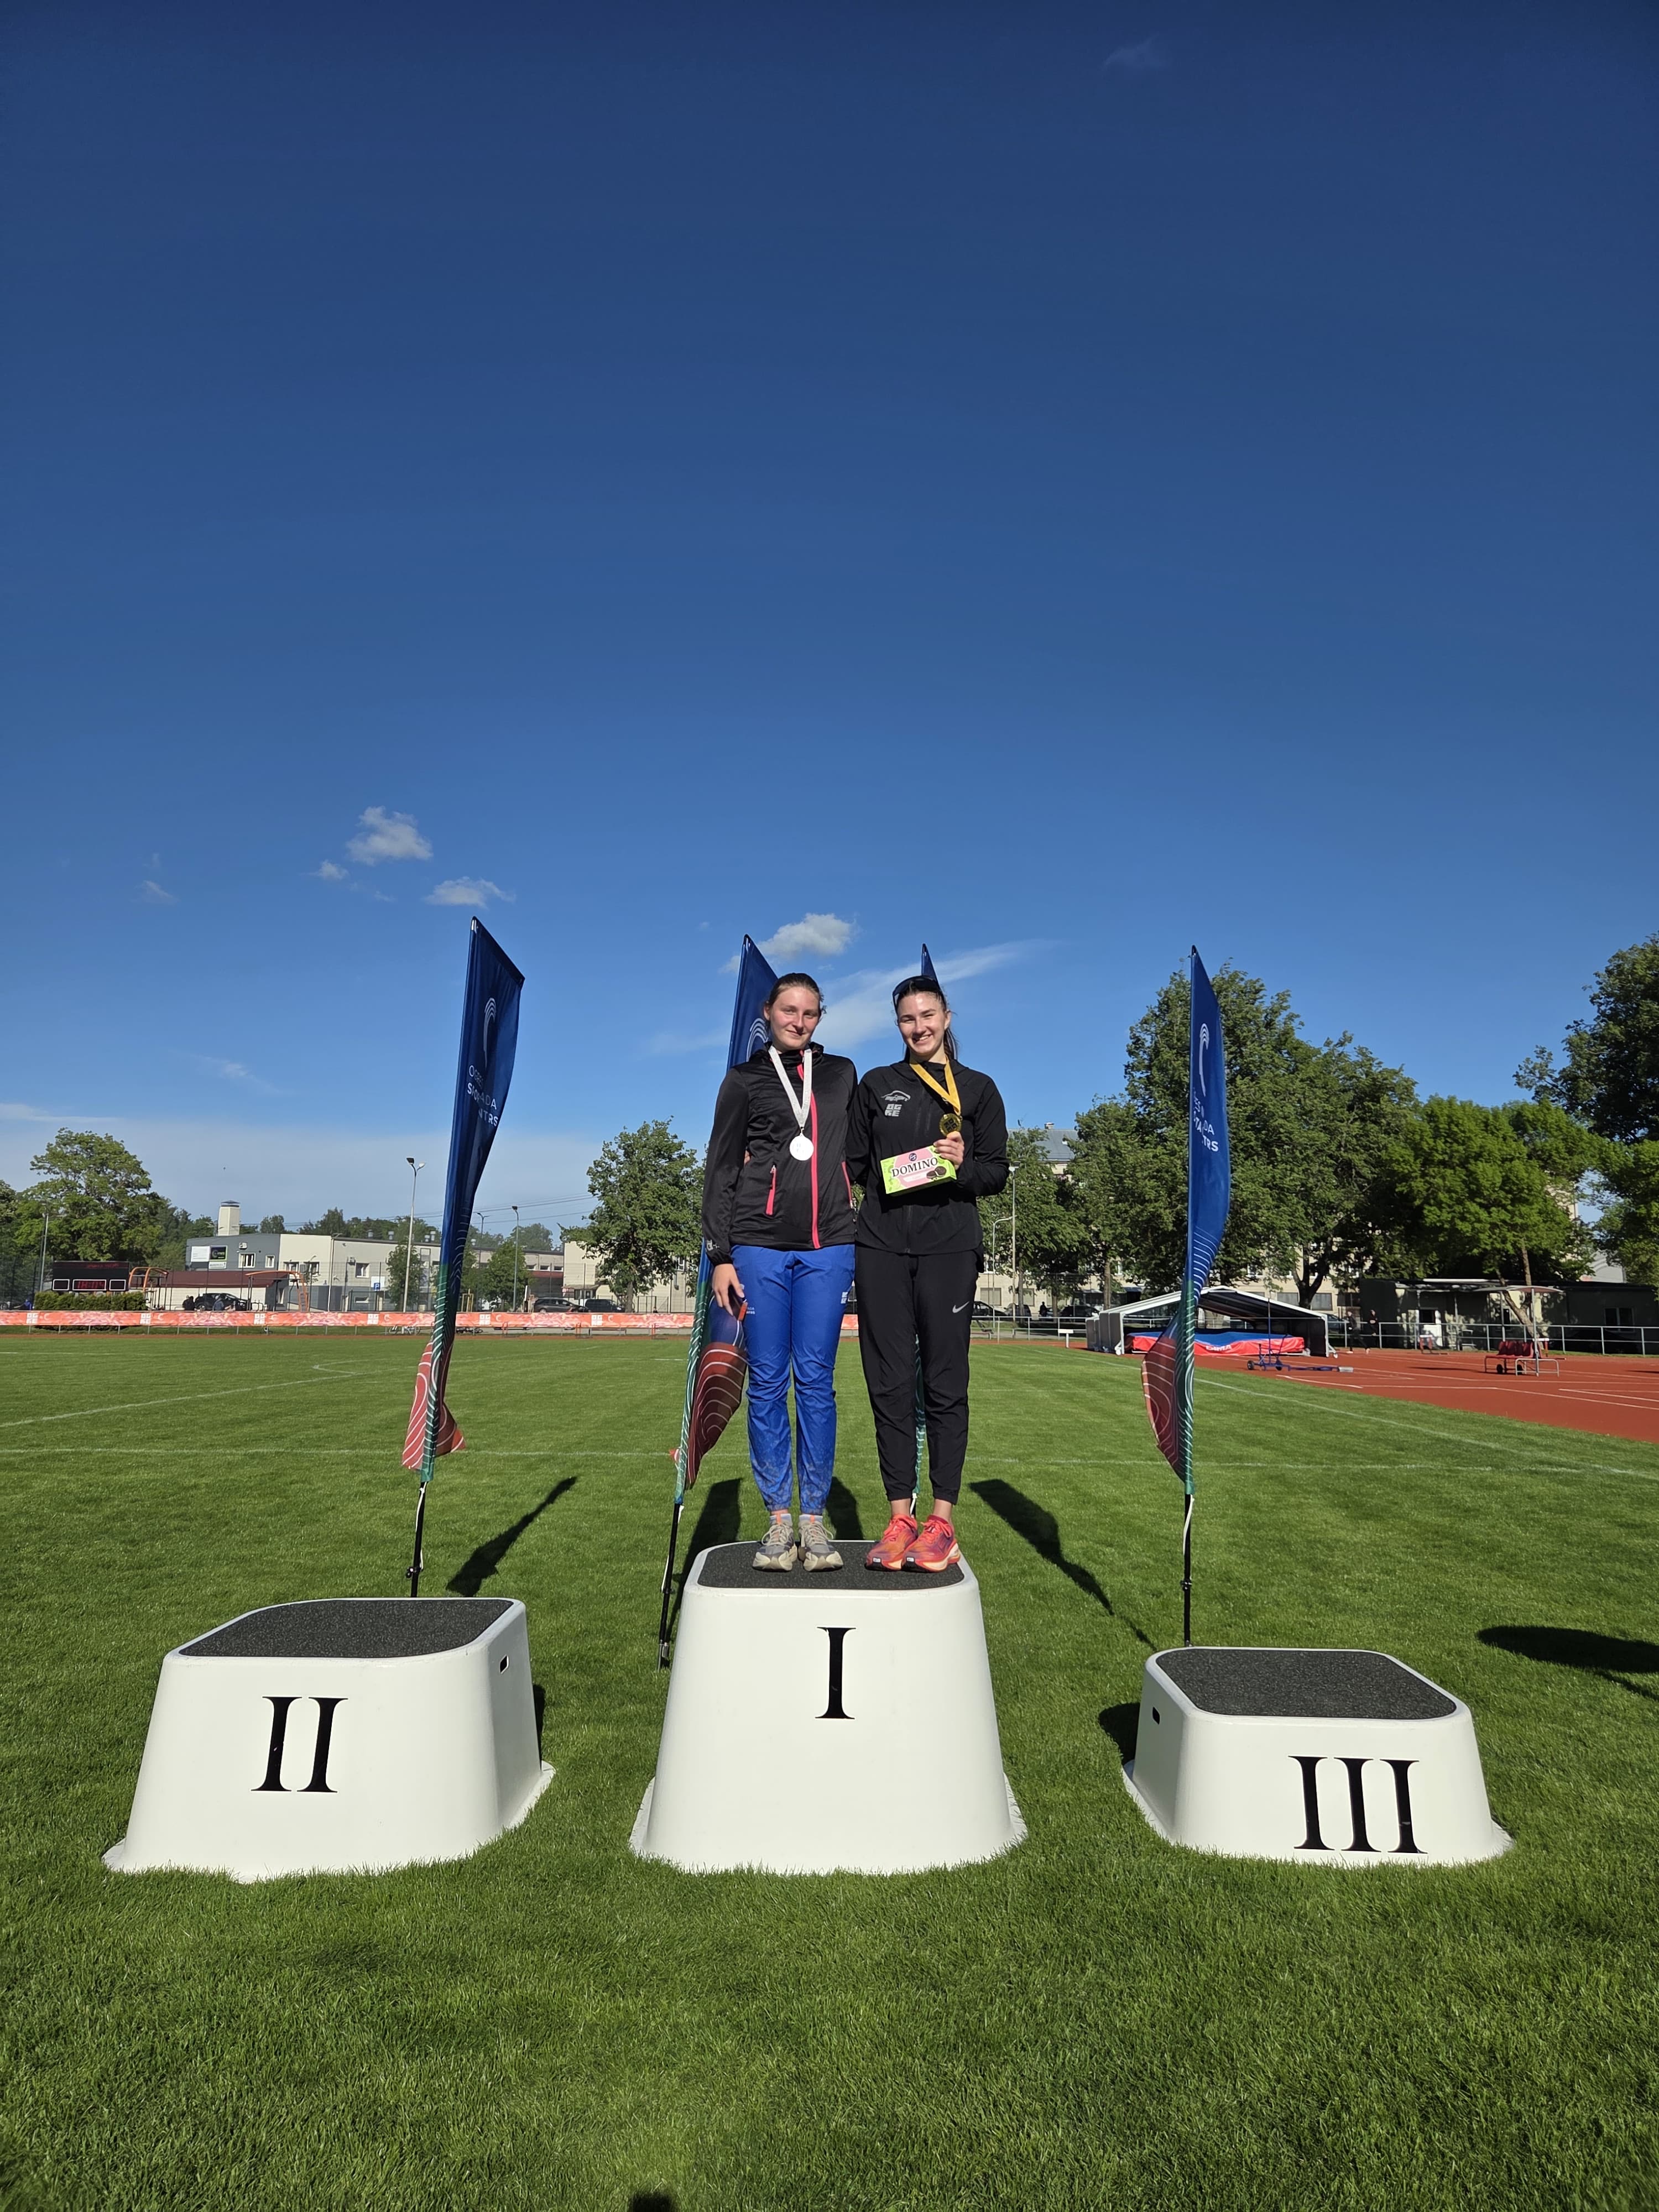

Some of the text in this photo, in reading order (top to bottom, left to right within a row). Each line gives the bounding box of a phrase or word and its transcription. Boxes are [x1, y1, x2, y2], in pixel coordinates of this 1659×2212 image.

[892, 1157, 938, 1177] DOMINO
[815, 1627, 856, 1719] I
[251, 1696, 348, 1793] II
[1288, 1756, 1428, 1854] III
